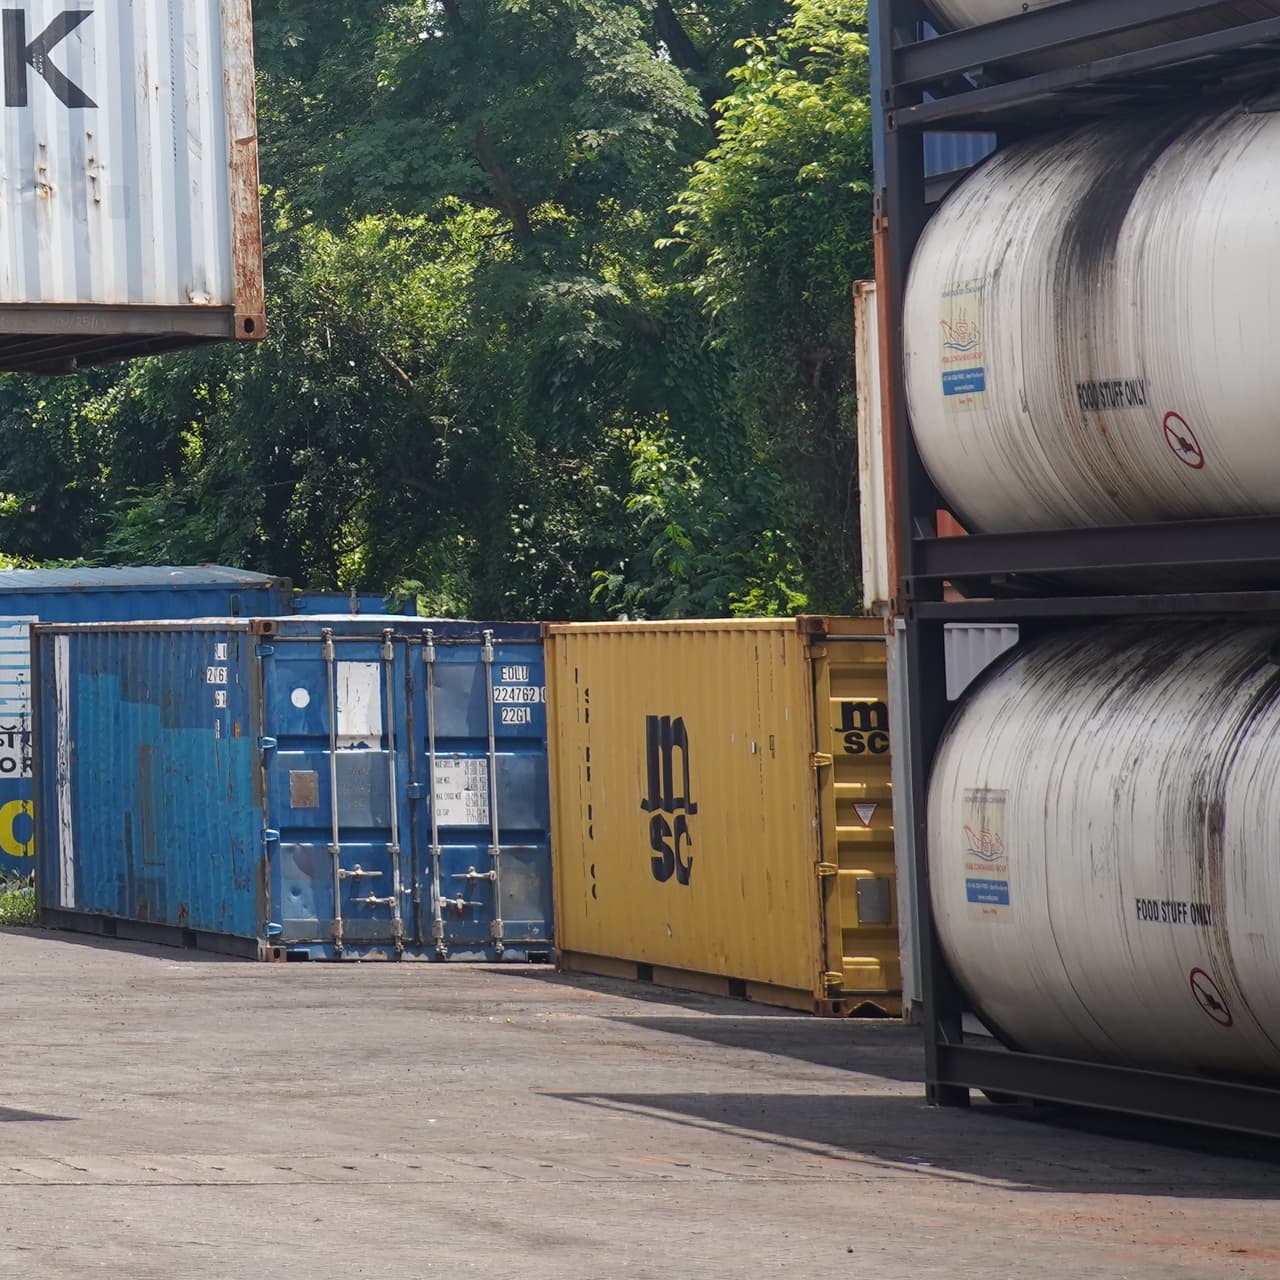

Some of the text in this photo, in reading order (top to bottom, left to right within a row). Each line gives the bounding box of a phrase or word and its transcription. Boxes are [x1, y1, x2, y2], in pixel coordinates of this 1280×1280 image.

[1099, 381, 1124, 408] STUFF
[501, 666, 528, 681] EOLU
[495, 687, 536, 702] 224762
[502, 708, 528, 723] 22G1
[1136, 898, 1212, 926] FOOD STUFF ONLY
